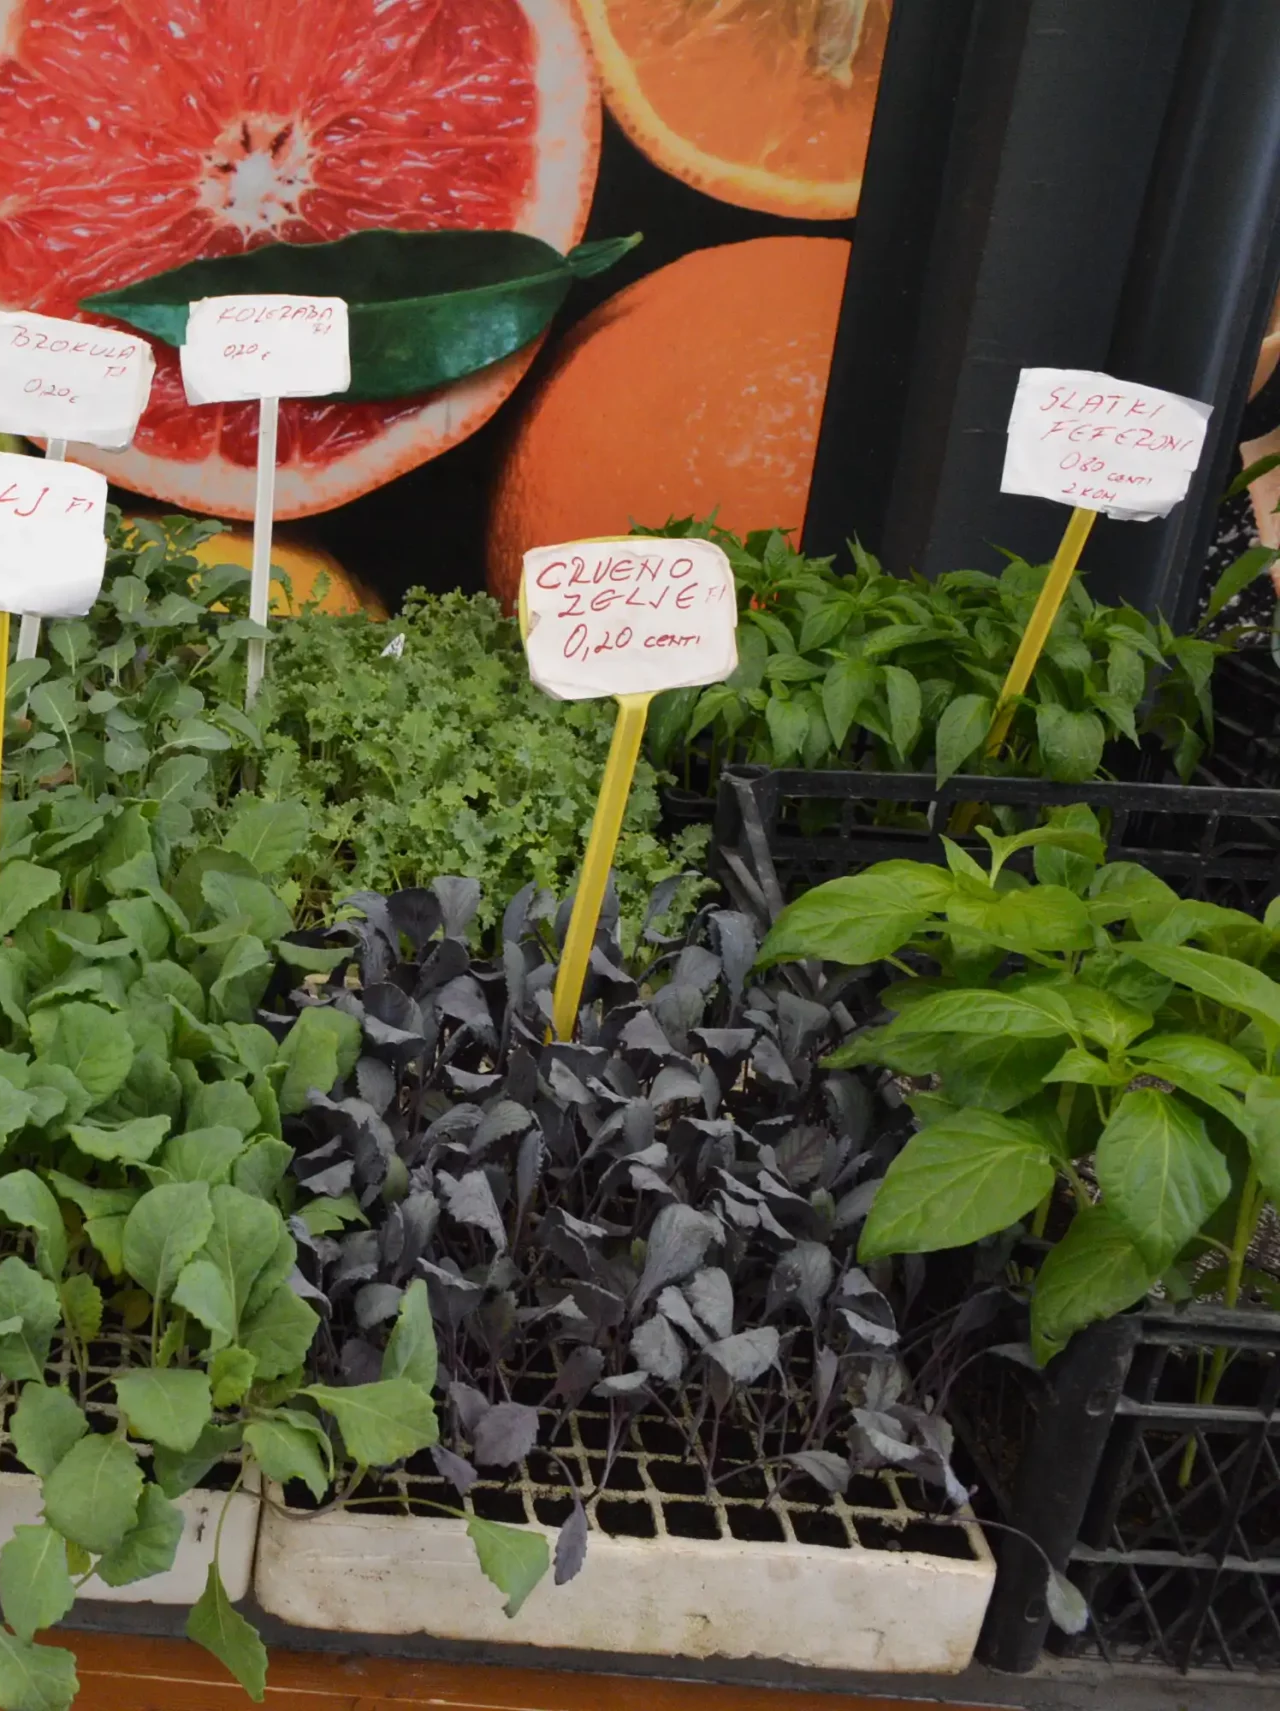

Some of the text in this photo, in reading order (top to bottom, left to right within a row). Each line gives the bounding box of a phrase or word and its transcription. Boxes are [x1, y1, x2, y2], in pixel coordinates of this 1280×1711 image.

[11, 325, 136, 359] BROKULA
[1040, 386, 1166, 418] SLATKI
[1040, 419, 1194, 452] FEFERONI
[1061, 482, 1117, 502] 2 KOM
[558, 583, 698, 618] ZELJE
[563, 623, 633, 662] 0,20
